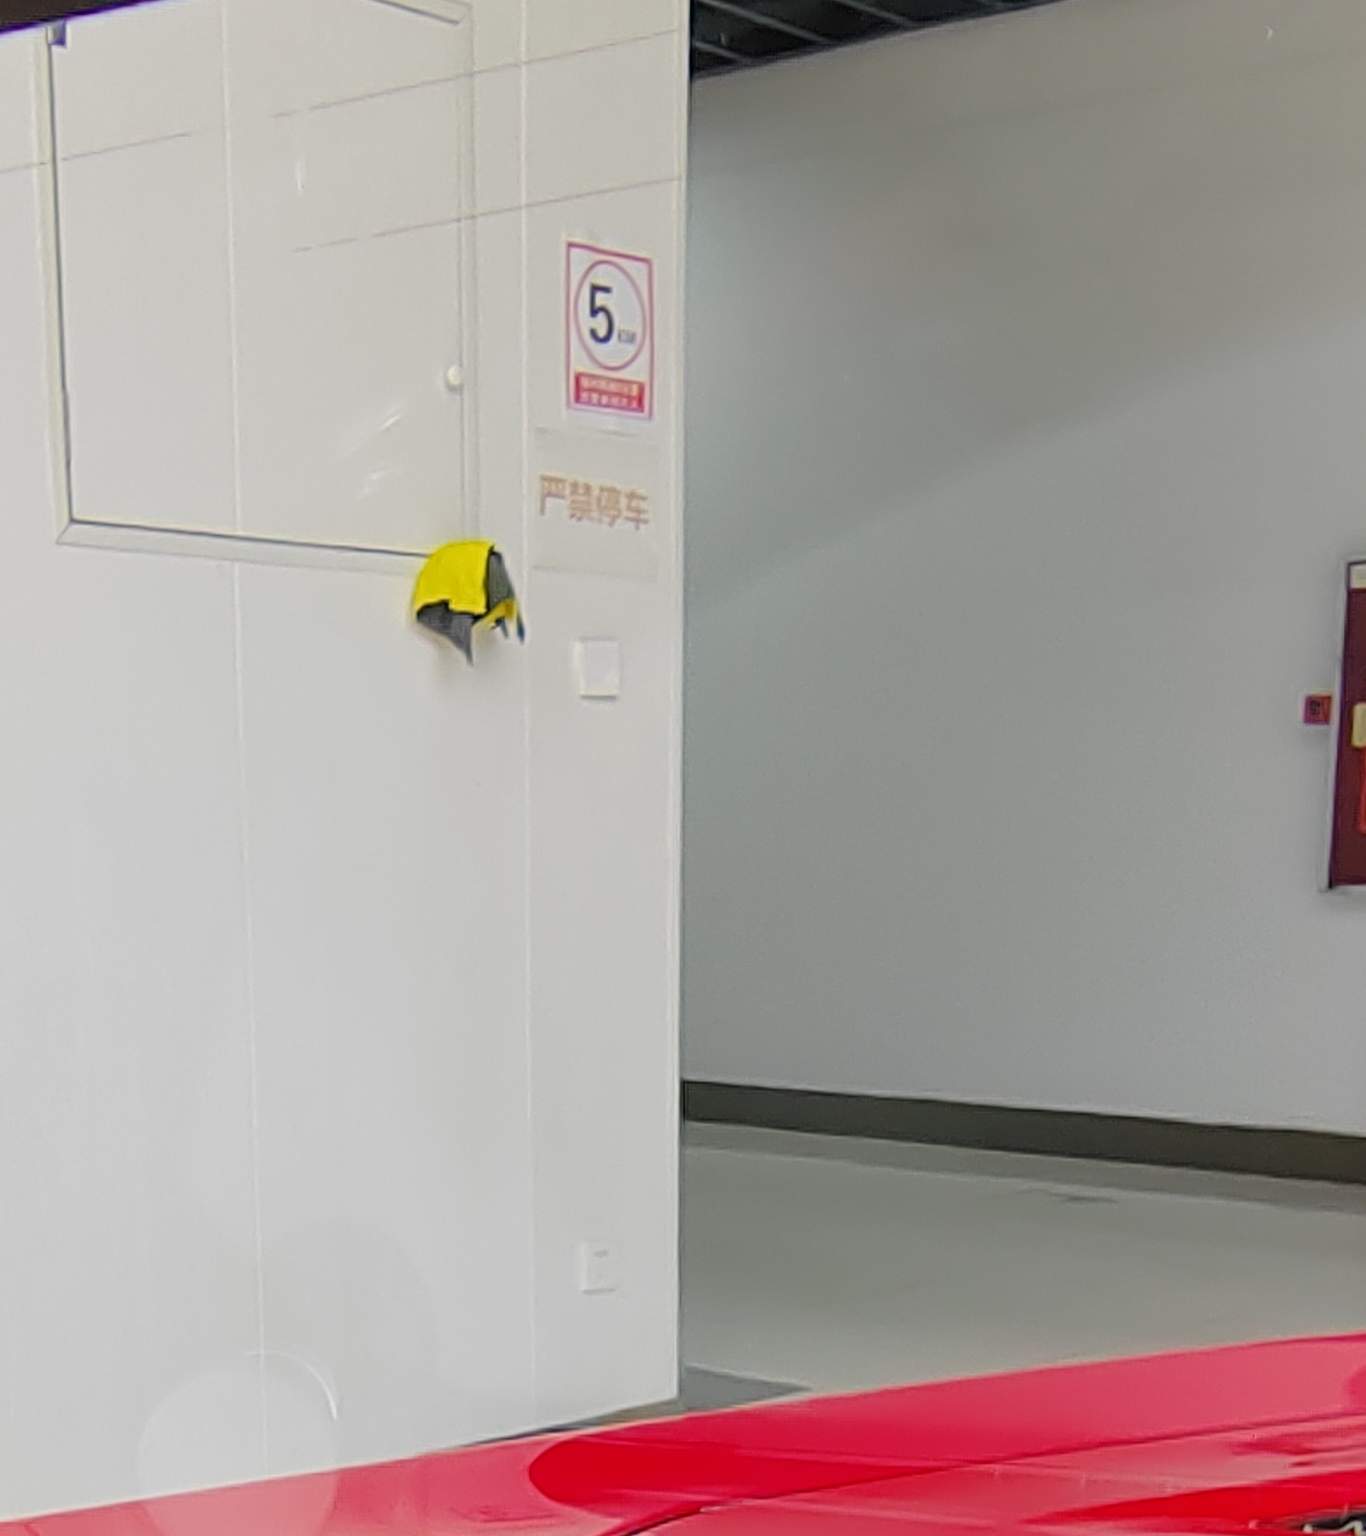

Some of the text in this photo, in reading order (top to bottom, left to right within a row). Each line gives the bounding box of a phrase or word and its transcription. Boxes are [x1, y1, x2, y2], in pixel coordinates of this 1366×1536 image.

[589, 282, 614, 344] 5
[539, 474, 649, 531] 严禁停车
